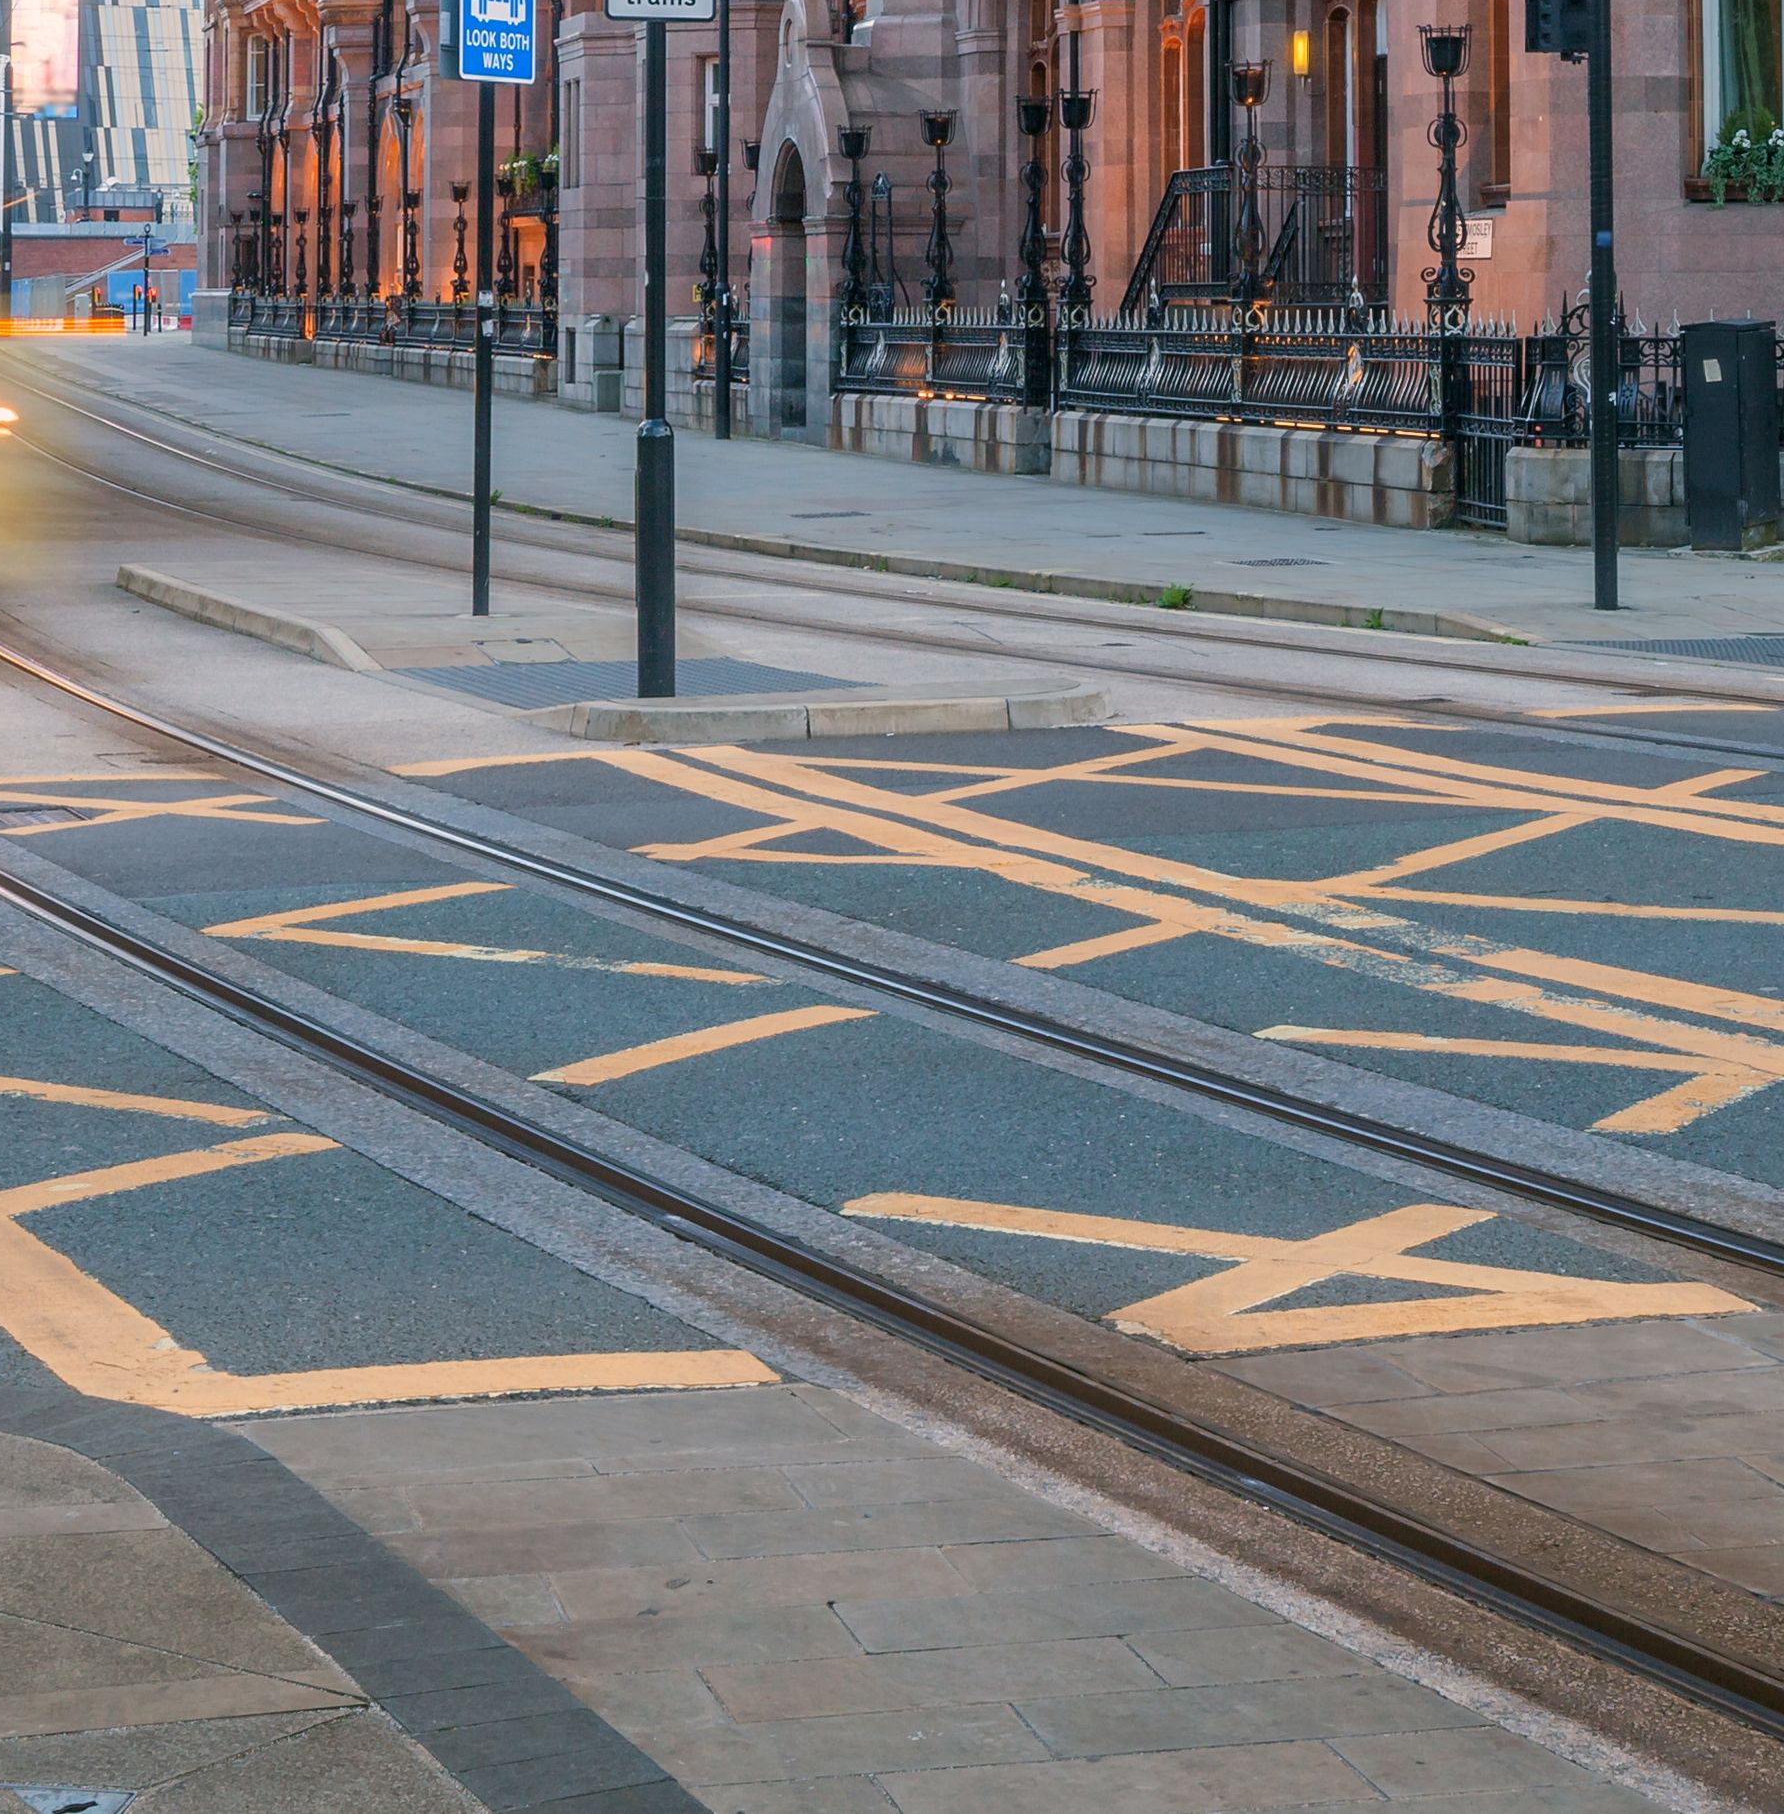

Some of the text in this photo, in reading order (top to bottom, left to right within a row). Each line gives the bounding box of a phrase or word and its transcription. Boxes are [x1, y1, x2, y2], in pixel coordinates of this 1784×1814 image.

[466, 29, 530, 51] LOOK BOTH
[482, 52, 514, 71] WAYS
